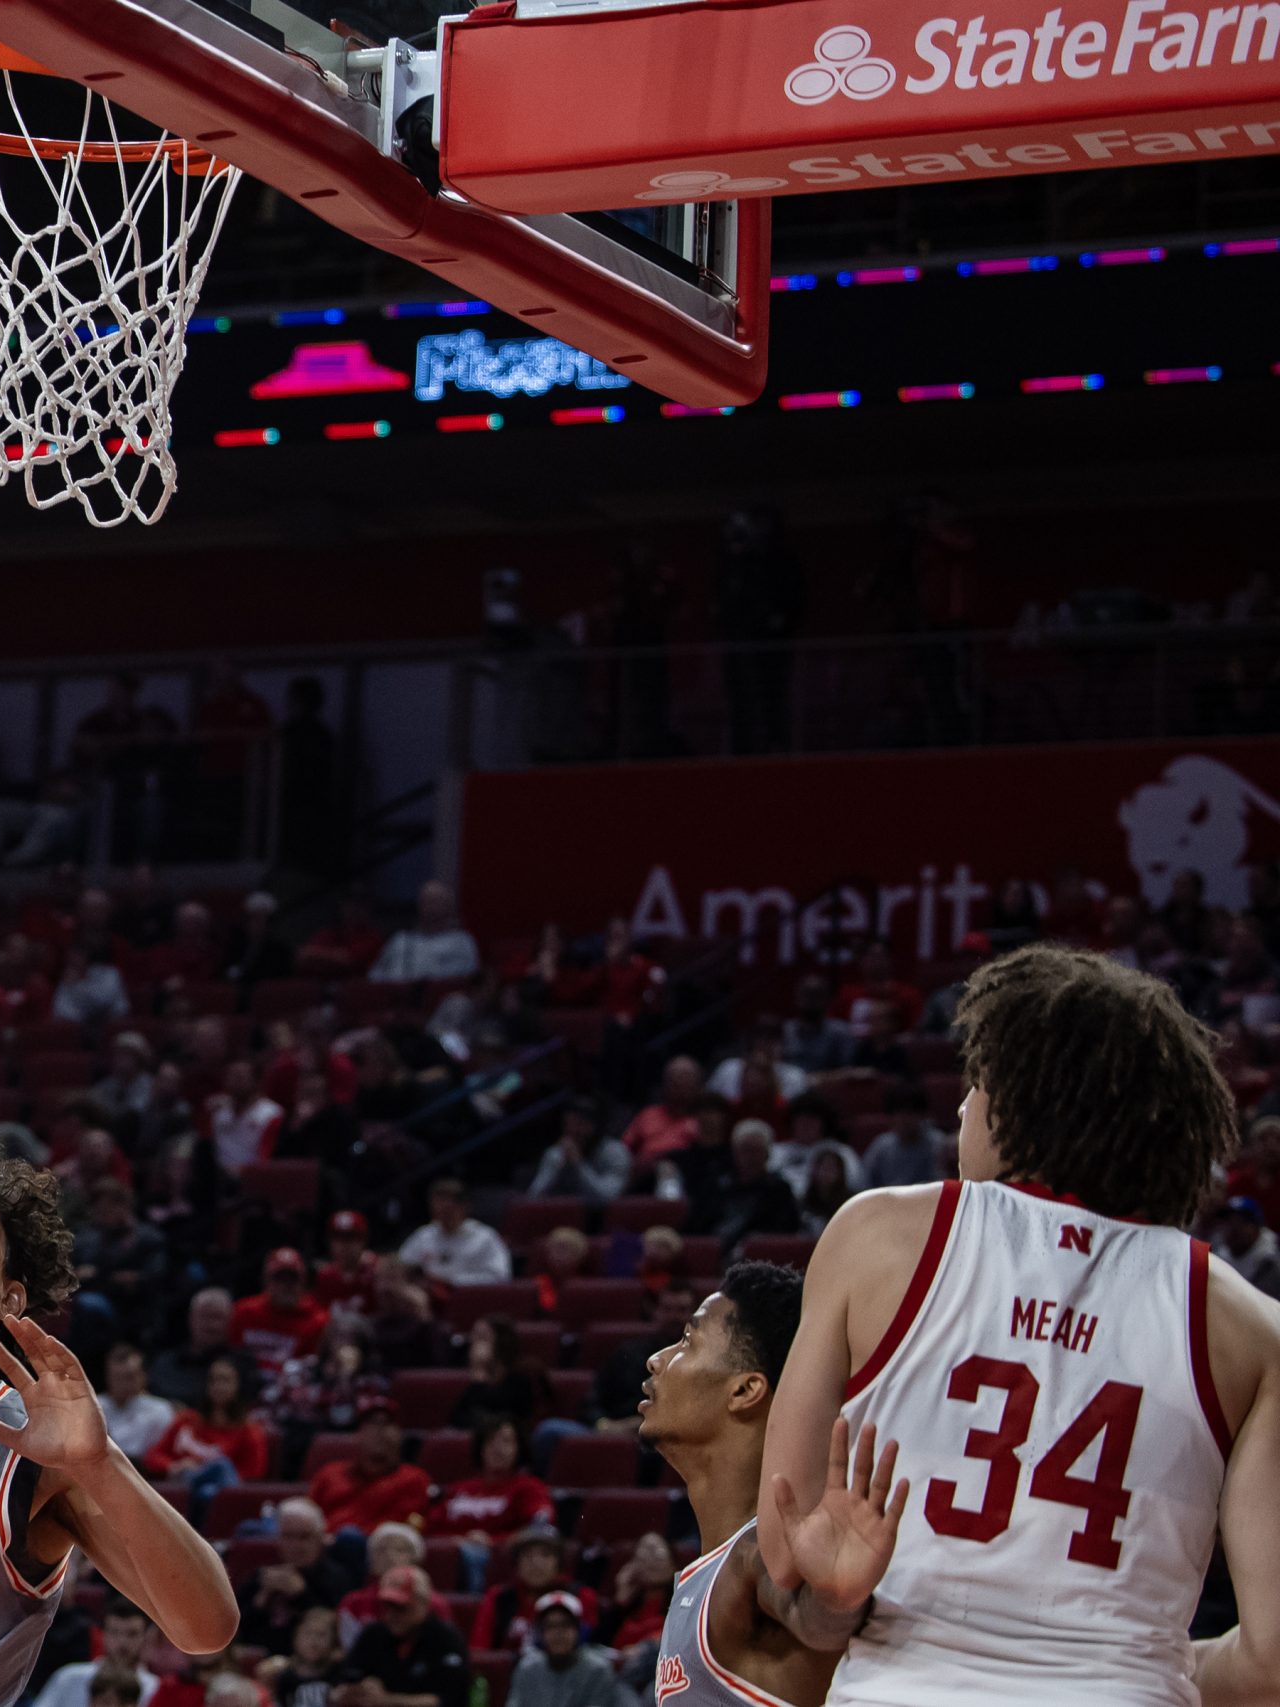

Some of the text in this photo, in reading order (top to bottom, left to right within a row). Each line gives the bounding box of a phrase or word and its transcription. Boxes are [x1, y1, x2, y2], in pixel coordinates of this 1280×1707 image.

[630, 863, 1109, 967] Amerit
[1058, 1224, 1094, 1257] N
[1010, 1296, 1098, 1354] MEAH
[923, 1354, 1144, 1570] 34
